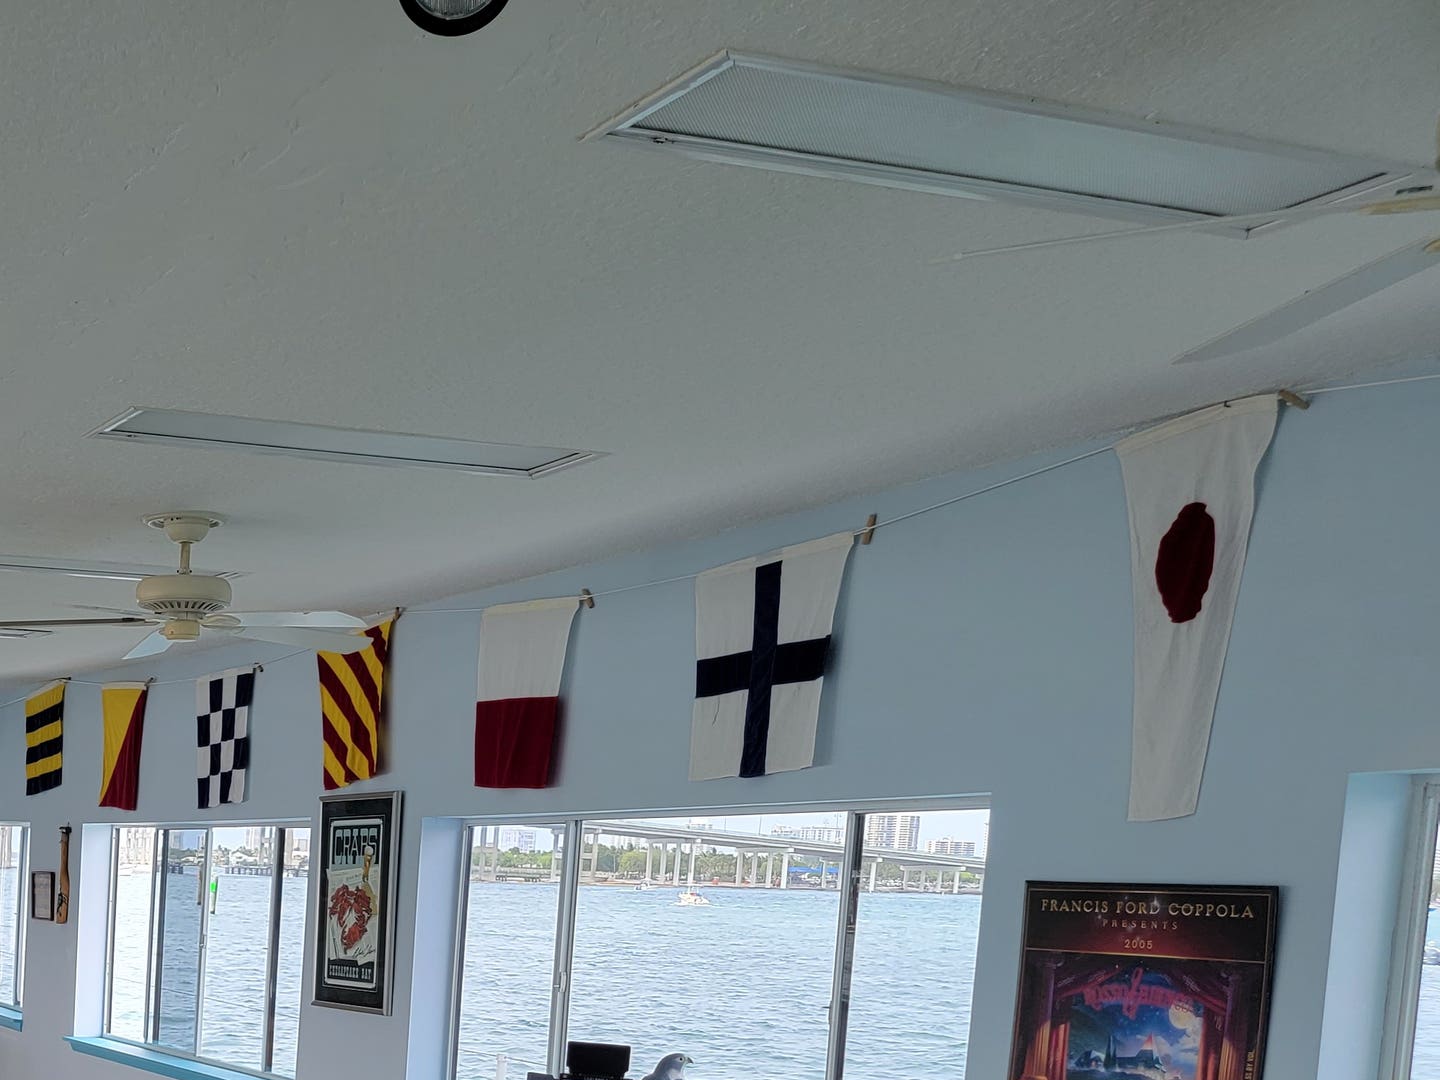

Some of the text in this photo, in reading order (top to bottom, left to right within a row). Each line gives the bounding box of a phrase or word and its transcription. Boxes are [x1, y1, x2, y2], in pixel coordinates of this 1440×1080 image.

[334, 827, 378, 864] CRABS
[1041, 899, 1254, 918] FRANCIS FORD COPPOLA
[1102, 918, 1178, 930] PRESENTS
[1124, 939, 1153, 949] 2005
